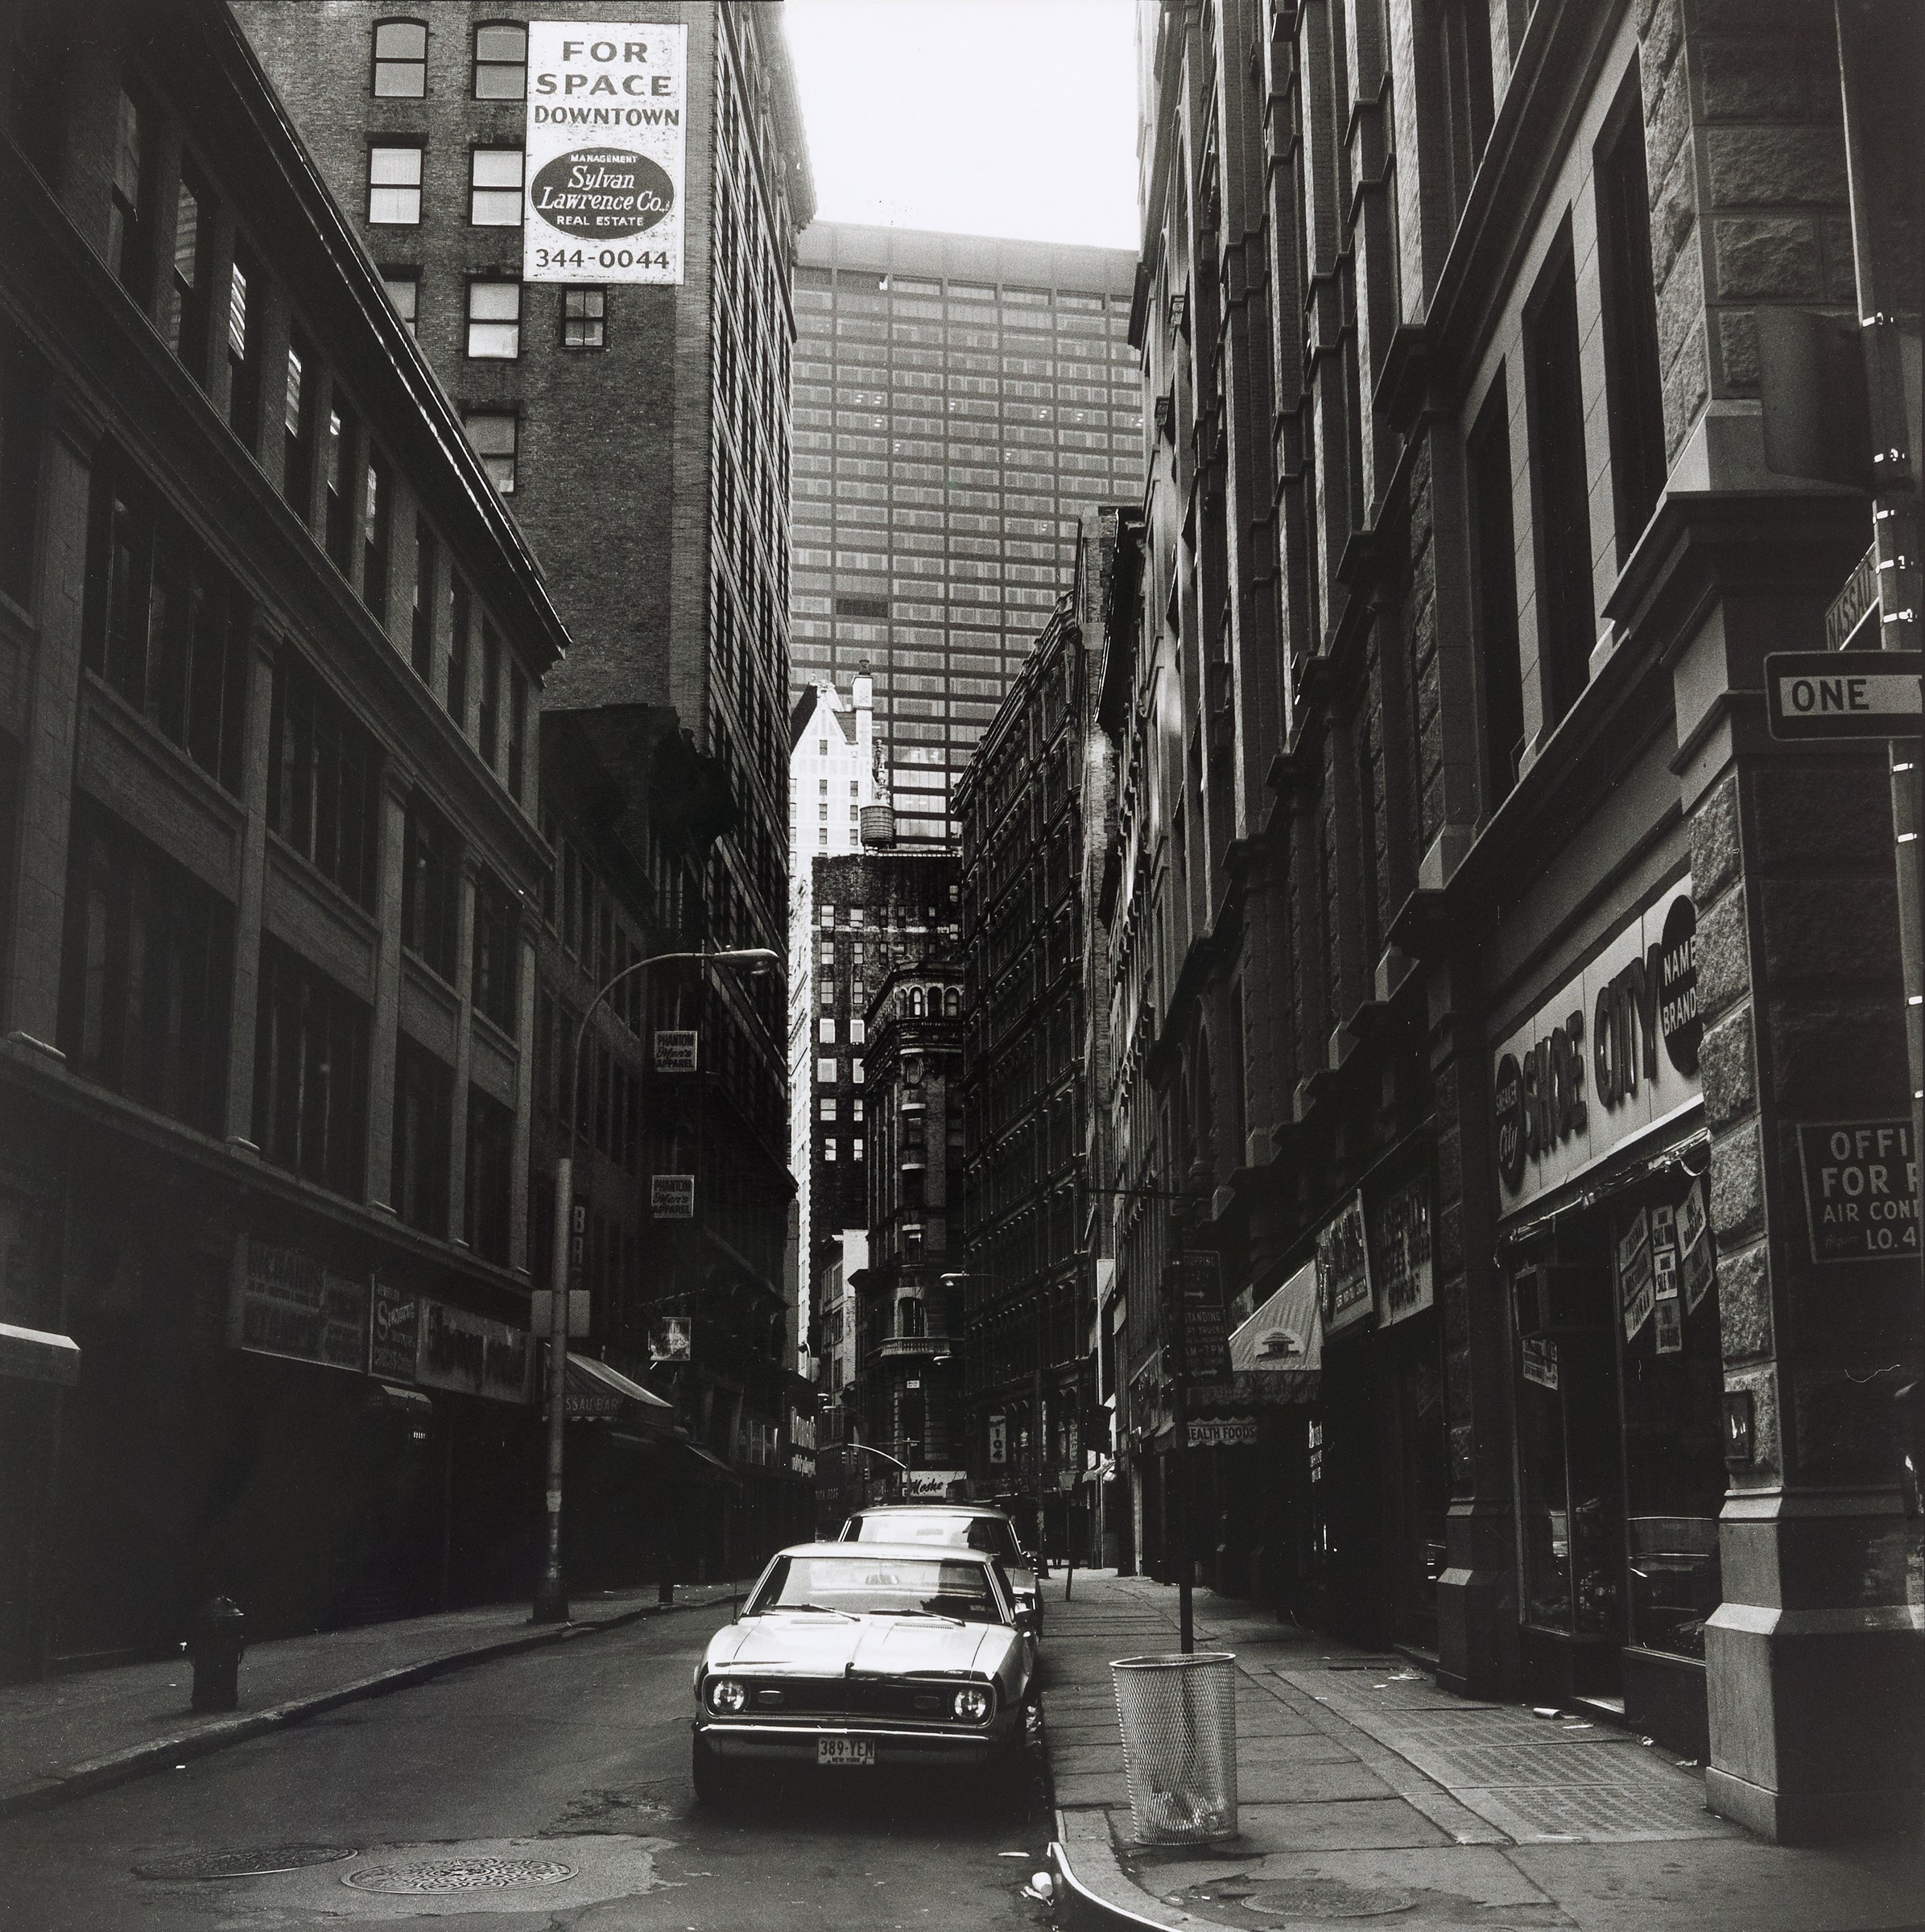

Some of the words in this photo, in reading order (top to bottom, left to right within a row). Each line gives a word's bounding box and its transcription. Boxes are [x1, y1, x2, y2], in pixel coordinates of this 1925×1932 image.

[563, 41, 648, 64] FOR
[535, 73, 672, 97] SPACE
[535, 105, 680, 126] DOWNTOWN
[570, 154, 638, 163] MANAGEMENT
[568, 164, 634, 191] Sylvan
[537, 186, 631, 211] Lawrence
[557, 216, 590, 226] REAL
[596, 216, 644, 227] ESTATE
[535, 248, 670, 270] 344-0044
[1791, 679, 1869, 712] ONE
[1663, 934, 1696, 987] NAME
[1663, 986, 1697, 1037] BRAND
[1522, 1009, 1588, 1159] SHOE
[1593, 942, 1662, 1108] CITY
[1829, 1128, 1908, 1161] OFFI
[1821, 1164, 1890, 1198] FOR
[1823, 1202, 1861, 1224] AIR
[565, 1397, 593, 1411] SSAU
[597, 1397, 619, 1411] BAR
[1223, 1426, 1256, 1439] FOODS
